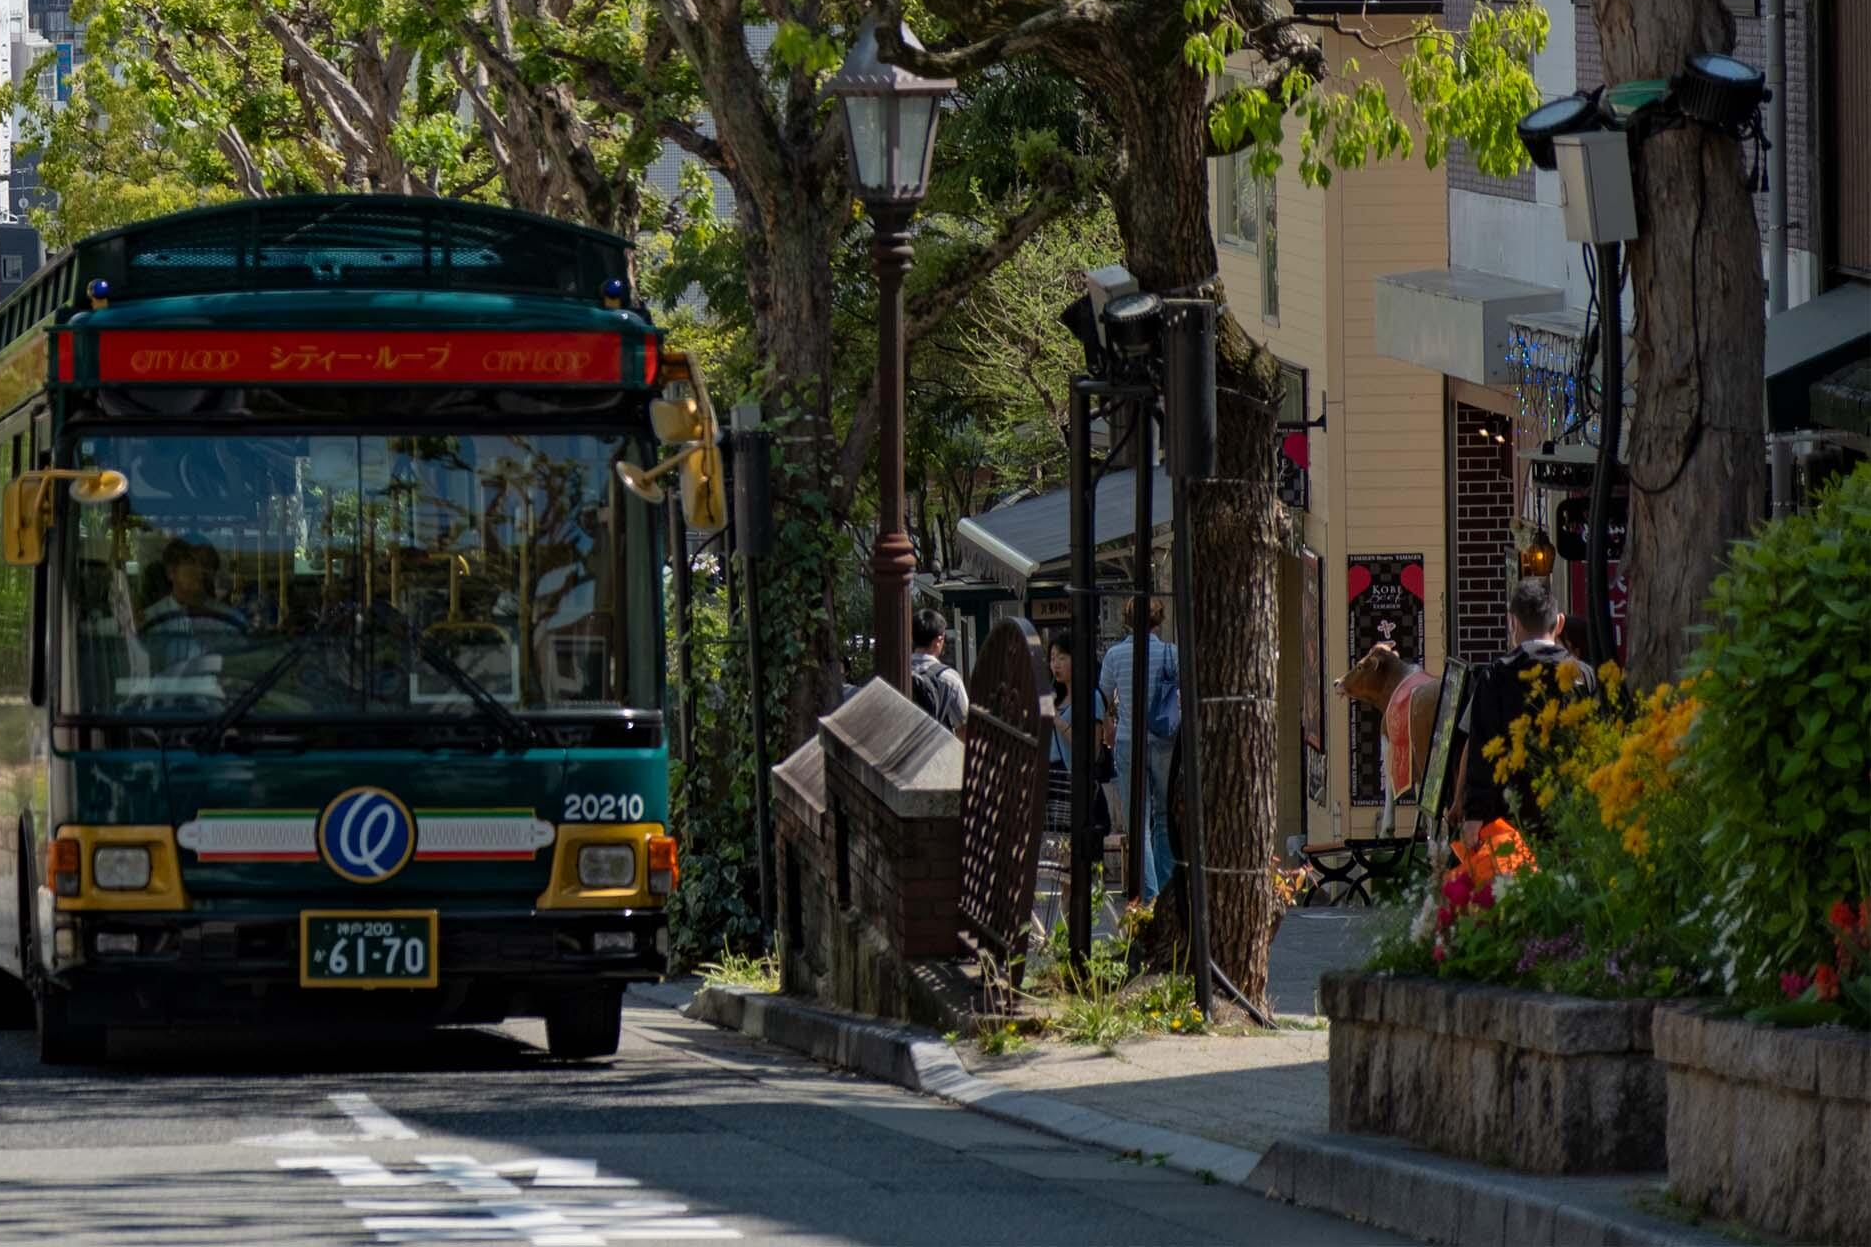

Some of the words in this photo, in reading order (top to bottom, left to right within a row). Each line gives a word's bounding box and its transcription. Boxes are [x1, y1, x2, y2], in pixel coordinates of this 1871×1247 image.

[131, 349, 179, 373] CITY
[180, 350, 240, 372] LOOP
[564, 794, 644, 820] 20210
[329, 937, 424, 974] 61-70
